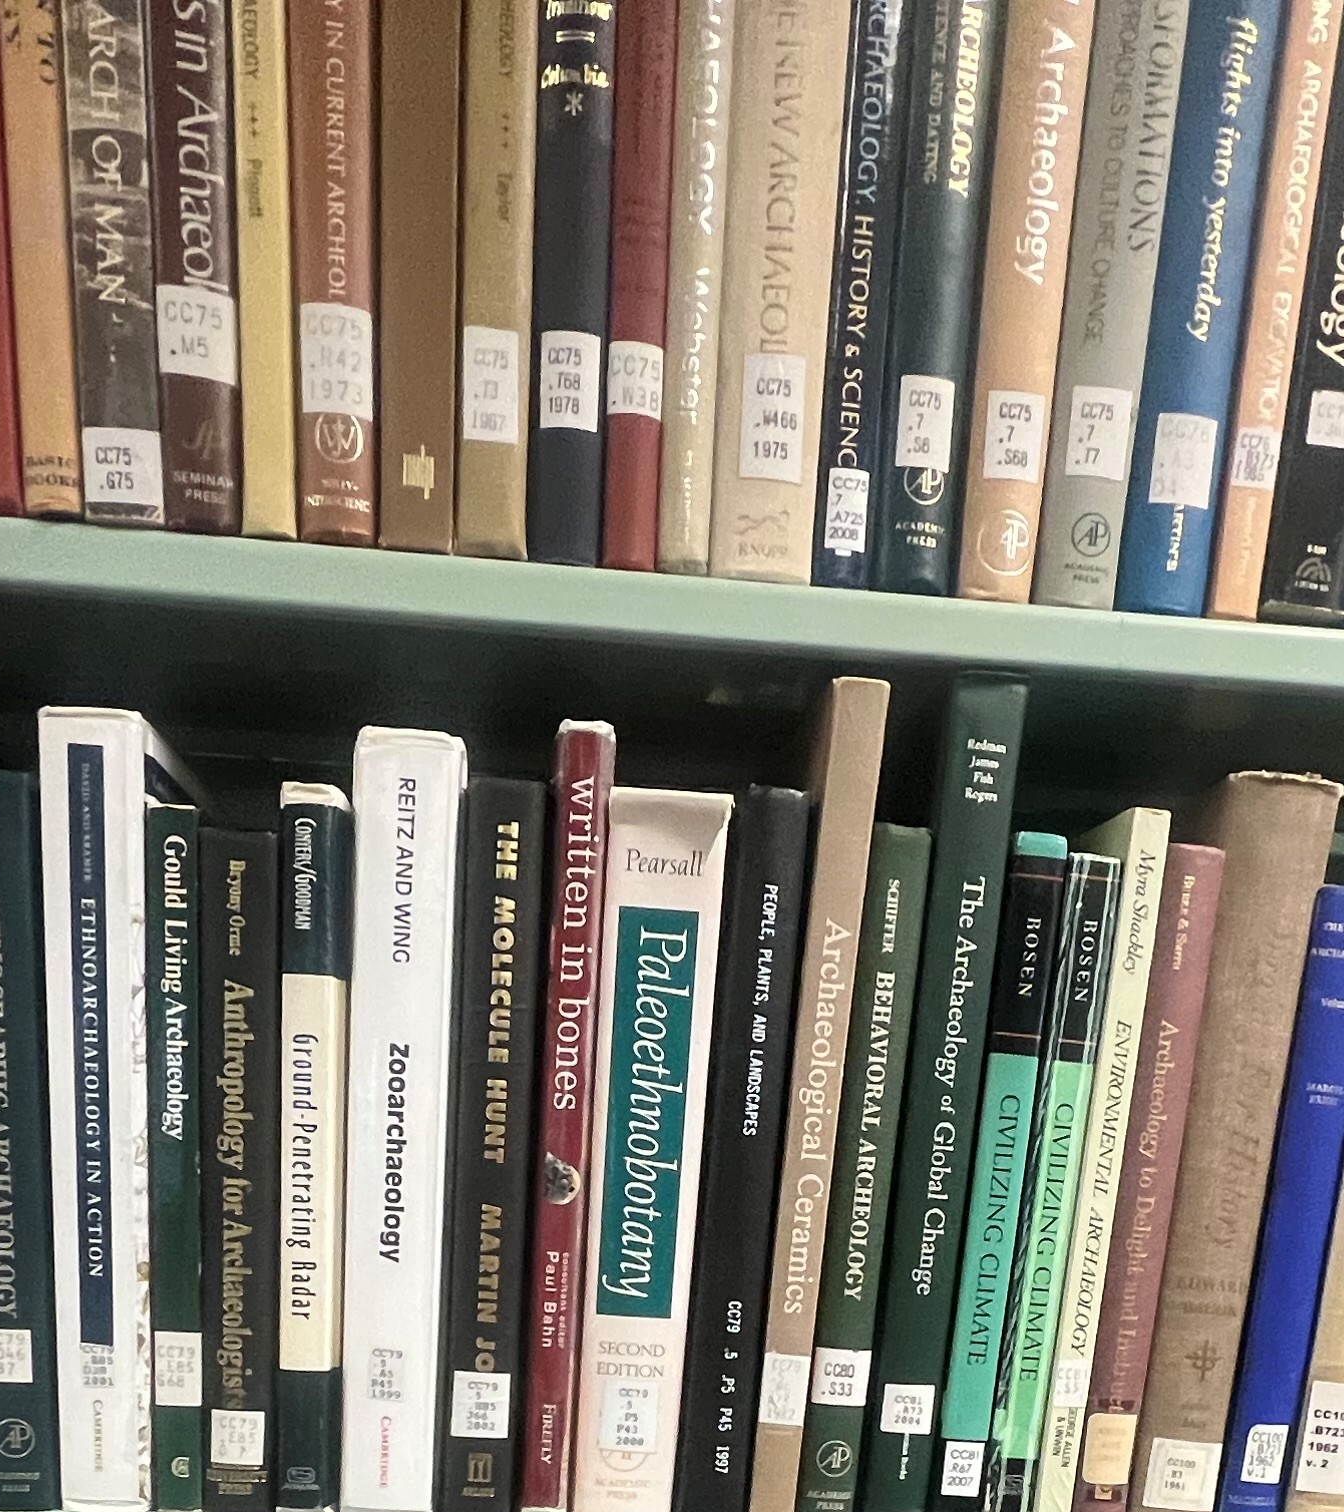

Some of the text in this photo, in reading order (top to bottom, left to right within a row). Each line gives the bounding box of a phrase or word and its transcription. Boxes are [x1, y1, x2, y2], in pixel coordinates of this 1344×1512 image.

[81, 134, 129, 305] OF MAN
[1013, 19, 1080, 293] Archaeology
[1185, 16, 1259, 342] flights into yesterday
[547, 347, 582, 366] CC75
[548, 396, 580, 415] 1978
[549, 373, 581, 391] .T68
[95, 446, 132, 466] CC75
[99, 471, 135, 490] .G75
[391, 776, 417, 964] REITZ AND WING
[552, 774, 595, 1112] written in bones
[625, 848, 703, 877] Pearsall
[1121, 847, 1157, 975] Myra Shackley
[159, 834, 189, 1141] Gould Living Archaeology
[482, 820, 520, 1164] THE MOLECULE HUNT
[741, 882, 779, 1137] PEOPLE, PLANTS, AND LANDSCAPES
[1016, 916, 1042, 998] ROSEN
[1073, 919, 1099, 1003] ROSEN
[79, 896, 104, 1277] ETHNOARCHAEOLOGY IN ACTION
[378, 1042, 410, 1264] Zooarchaeology
[602, 925, 690, 1298] Paleoethnobotany
[782, 916, 851, 1315] Archaeological Ceramics
[843, 877, 901, 1301] SCHIFFER BEHAVIORAL ARCHEOLOGY
[910, 874, 986, 1296] The Archaeology of Global Change
[285, 1032, 319, 1320] Ground-Penetrating Radar
[475, 1202, 502, 1324] MARTIN
[965, 1093, 1021, 1367] CIVILIZING CLIMATE
[1017, 1101, 1074, 1382] CIVILIZING CLIMATE
[1069, 1019, 1133, 1357] ENVIRONMENTAL ARCHAEOLOGY
[725, 1299, 743, 1334] CC79
[820, 1381, 853, 1397] .S33
[823, 1361, 855, 1379] CC80
[713, 1444, 730, 1475] 1997
[716, 1406, 733, 1433] P45
[1307, 1441, 1339, 1454] 1962
